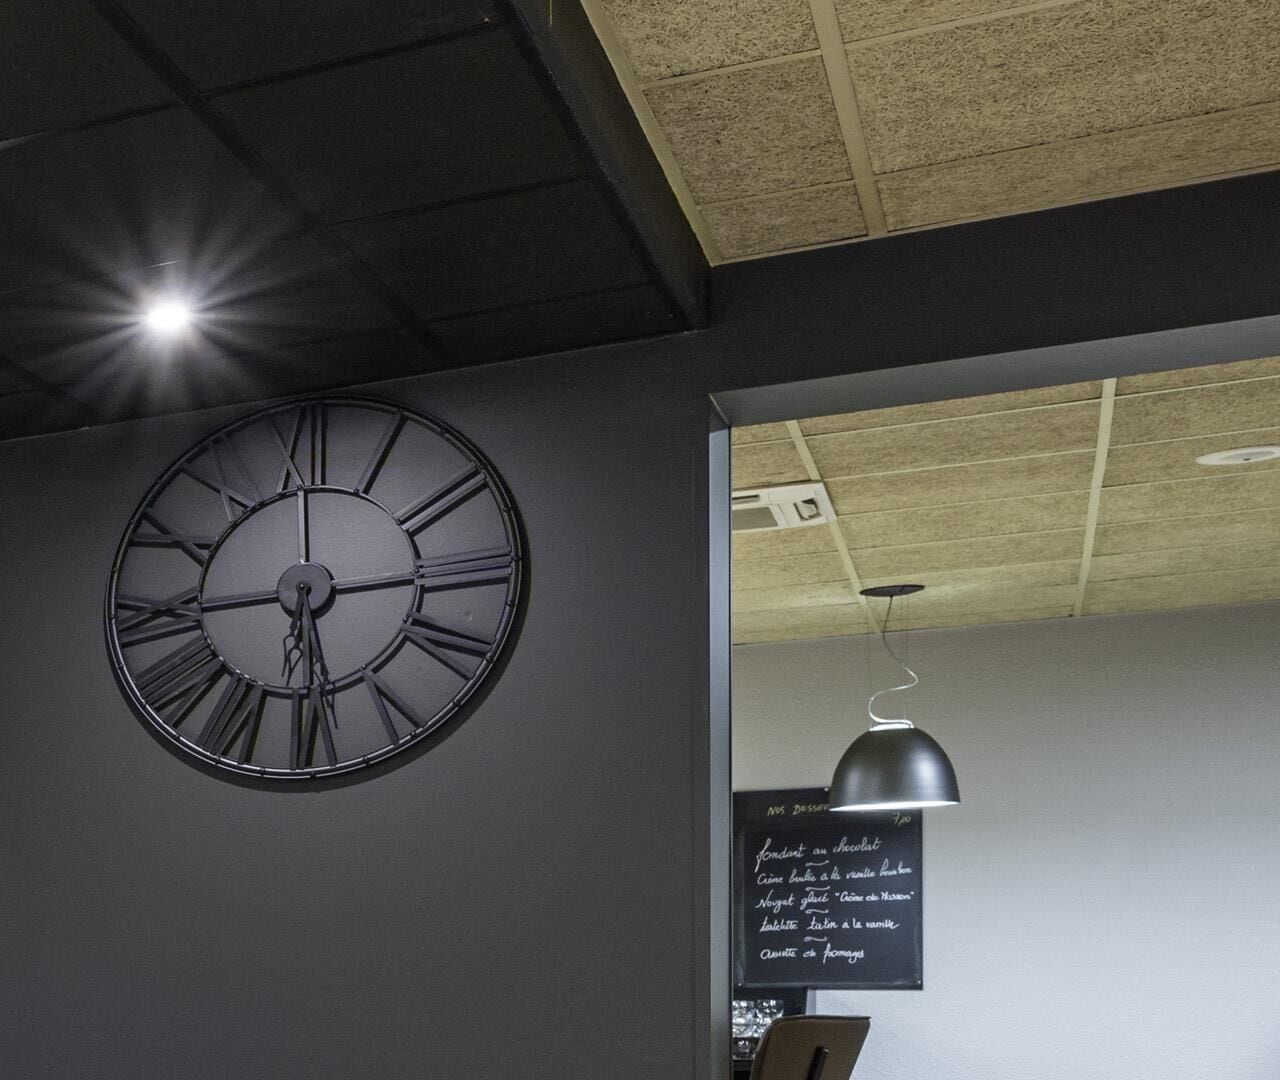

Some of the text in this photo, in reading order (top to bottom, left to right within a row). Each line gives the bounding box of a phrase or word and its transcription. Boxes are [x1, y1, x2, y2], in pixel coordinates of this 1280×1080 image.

[767, 806, 785, 816] NOS
[754, 836, 883, 873] fondant au chocolat
[830, 866, 841, 880] la
[846, 866, 876, 879] vanille
[755, 889, 795, 913] Nougat
[799, 891, 830, 910] glacé
[853, 917, 863, 929] la
[865, 919, 900, 930] vanille
[822, 942, 865, 964] fromages
